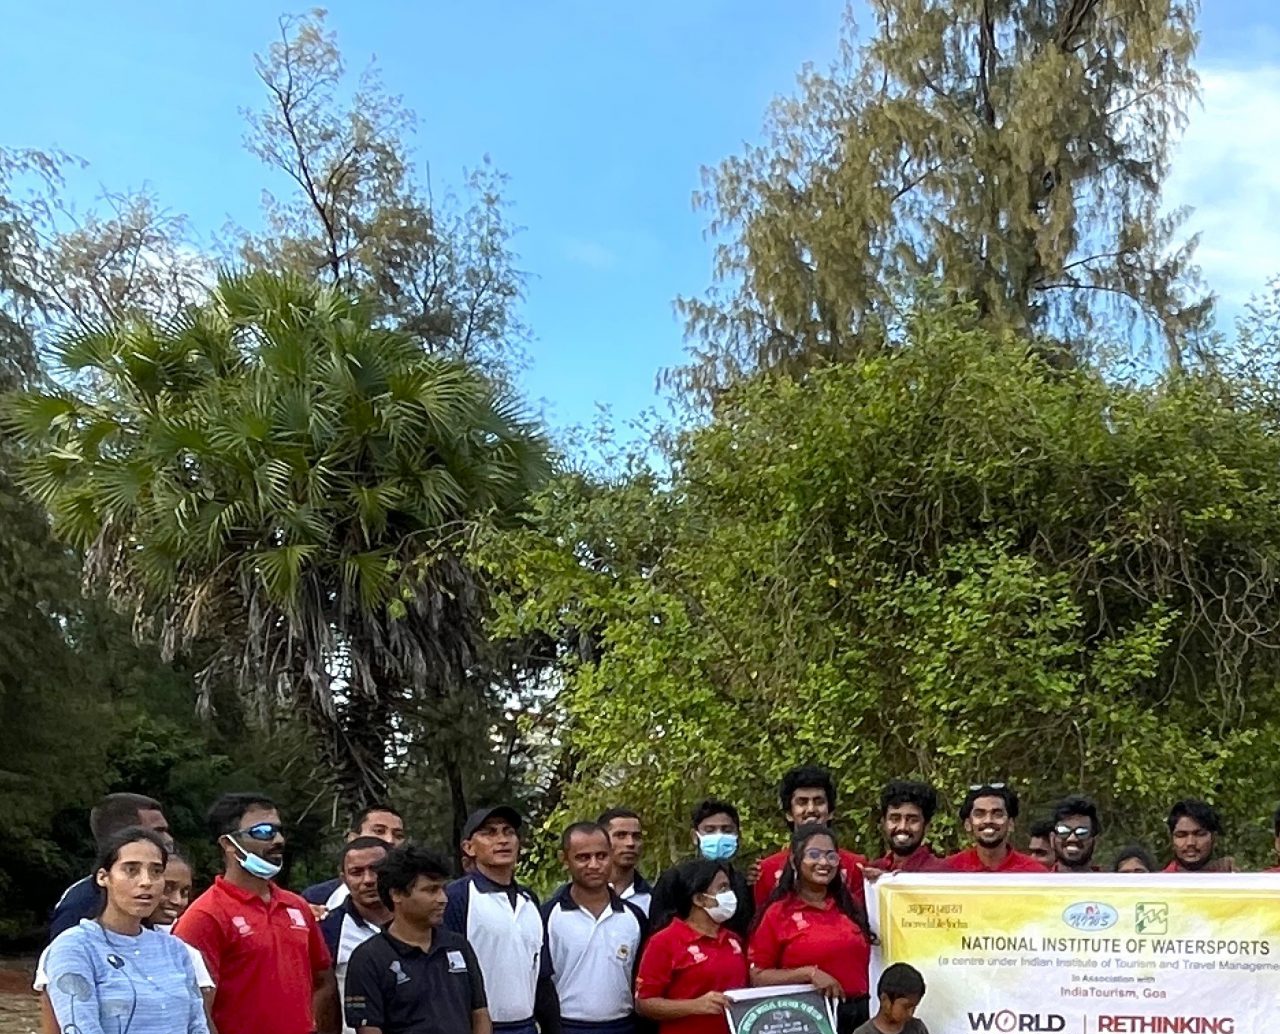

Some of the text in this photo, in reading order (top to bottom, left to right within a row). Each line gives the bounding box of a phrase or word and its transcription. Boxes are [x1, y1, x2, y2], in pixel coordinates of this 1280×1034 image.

[961, 936, 1038, 951] NATIONAL
[1042, 937, 1121, 953] INSTITUTE
[1125, 938, 1147, 954] OF
[1151, 939, 1271, 955] WATERSPORTS
[952, 957, 985, 966] centre
[987, 956, 1017, 966] under
[1021, 956, 1053, 967] Indian
[1056, 957, 1098, 968] Institute
[1101, 958, 1112, 968] of
[1115, 958, 1156, 969] Tourism
[1158, 959, 1179, 970] and
[1183, 959, 1216, 970] Travel
[1082, 974, 1135, 983] Association
[1143, 988, 1167, 999] Goa
[967, 1009, 1066, 1032] WORLD
